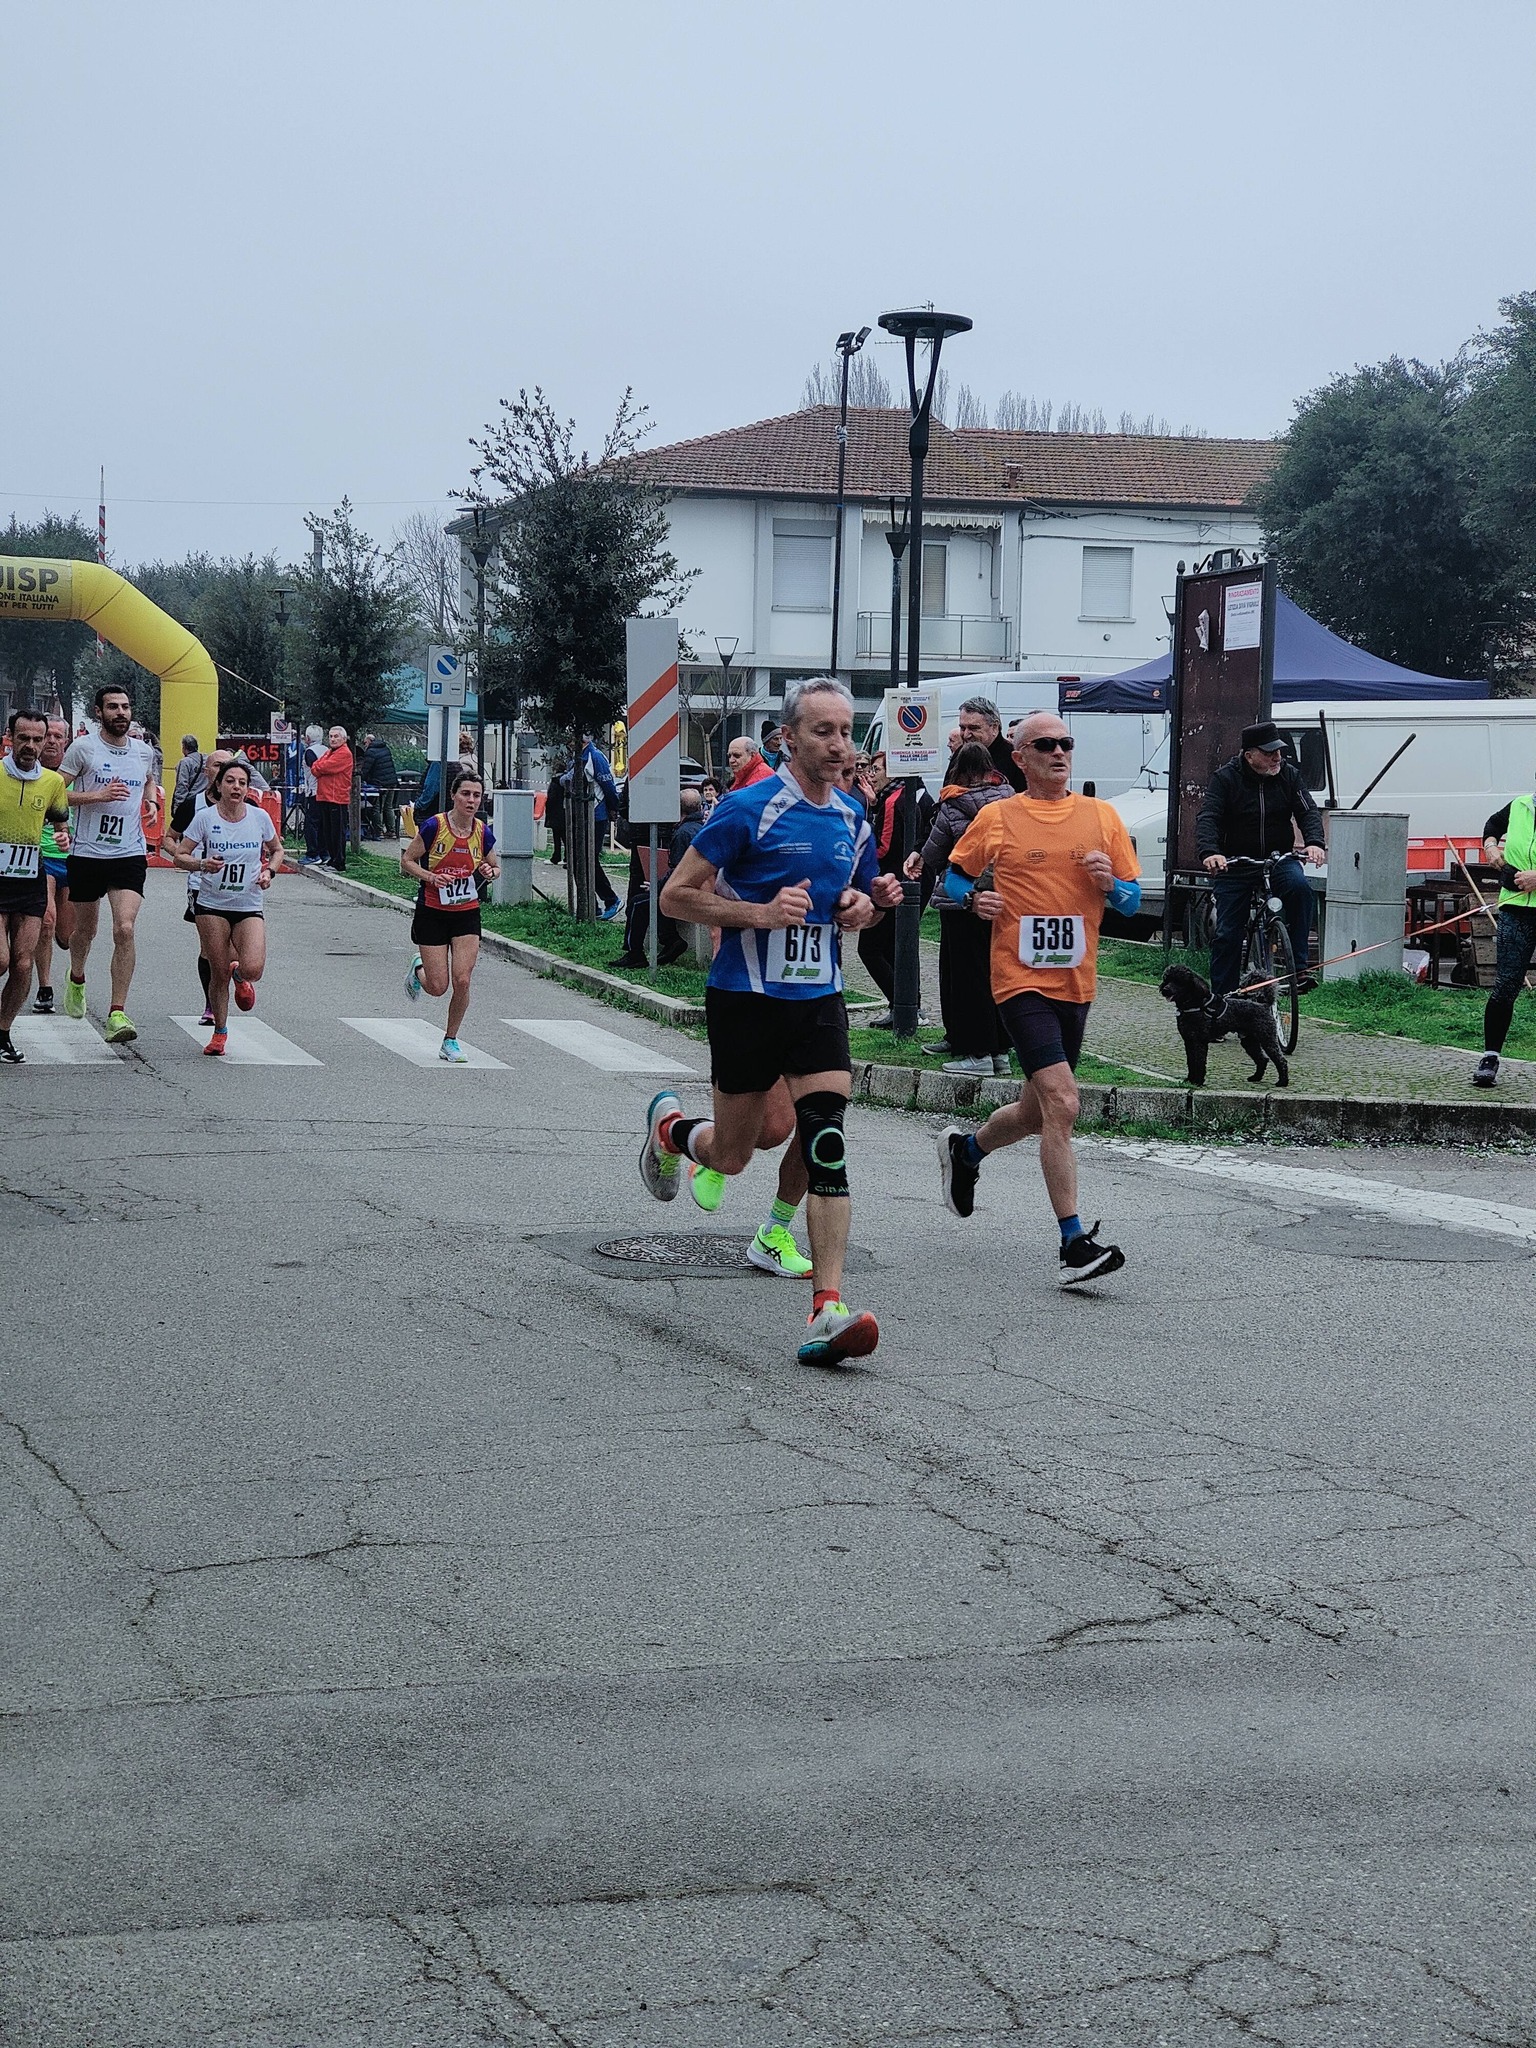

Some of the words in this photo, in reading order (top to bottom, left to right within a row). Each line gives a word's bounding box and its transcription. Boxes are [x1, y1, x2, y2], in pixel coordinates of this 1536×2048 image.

[0, 566, 59, 592] ISP
[11, 601, 28, 609] PER
[20, 594, 59, 603] ITALIANA
[432, 684, 440, 693] P
[239, 744, 279, 760] 6:15
[94, 774, 141, 787] lugesina
[100, 814, 124, 836] 621
[9, 845, 34, 866] 777
[209, 840, 259, 852] lughesina
[222, 863, 246, 883] 767
[446, 877, 471, 897] 522
[785, 924, 822, 962] 673
[1032, 917, 1074, 950] 538
